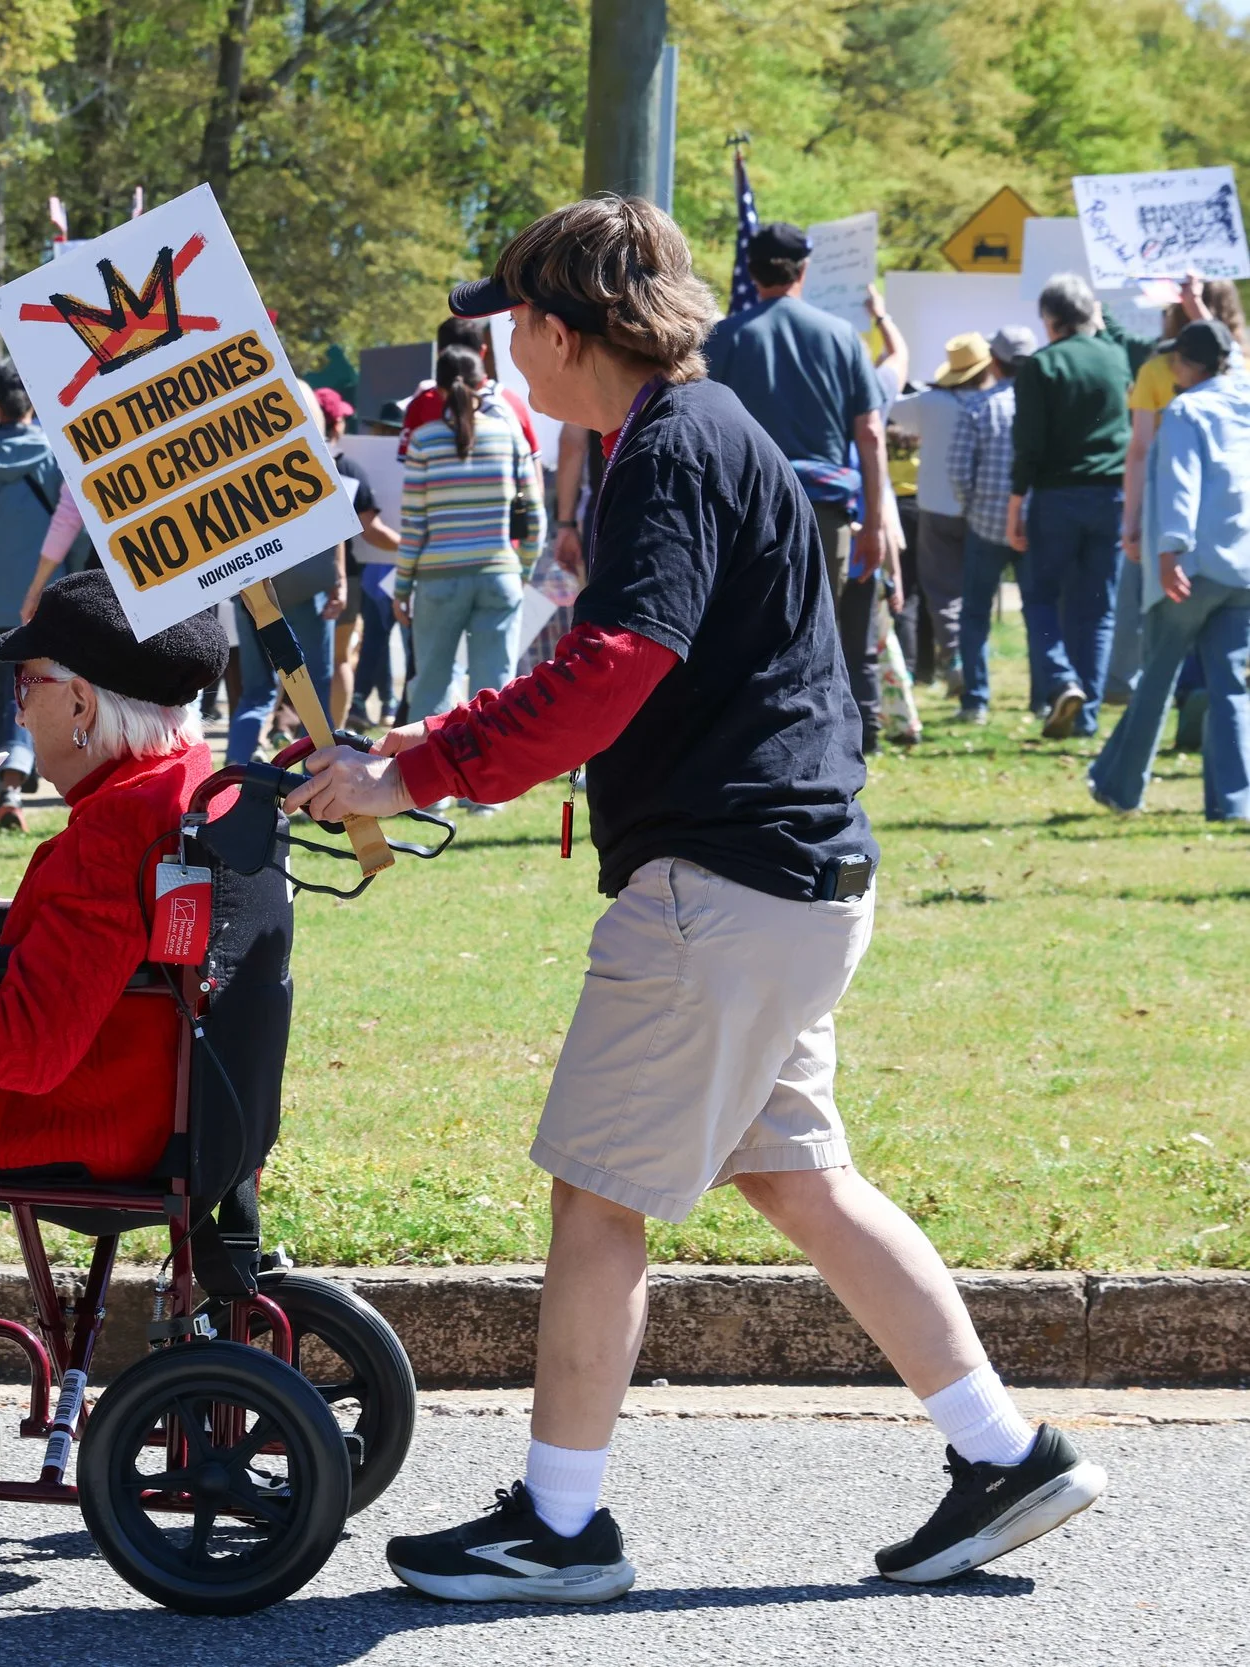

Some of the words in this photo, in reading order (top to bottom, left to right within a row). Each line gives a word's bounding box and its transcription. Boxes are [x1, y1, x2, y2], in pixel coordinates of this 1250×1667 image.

[68, 408, 121, 463] NO
[116, 335, 268, 427] THRONES
[93, 462, 147, 518] NO
[147, 391, 293, 491] CROWNS
[118, 515, 189, 588] NO
[184, 449, 324, 553] KINGS
[197, 538, 284, 590] NOKINGS.ORG
[168, 934, 177, 955] Center
[171, 920, 179, 934] Law
[175, 921, 187, 956] International
[185, 922, 195, 939] Dean
[182, 940, 192, 956] Rusk
